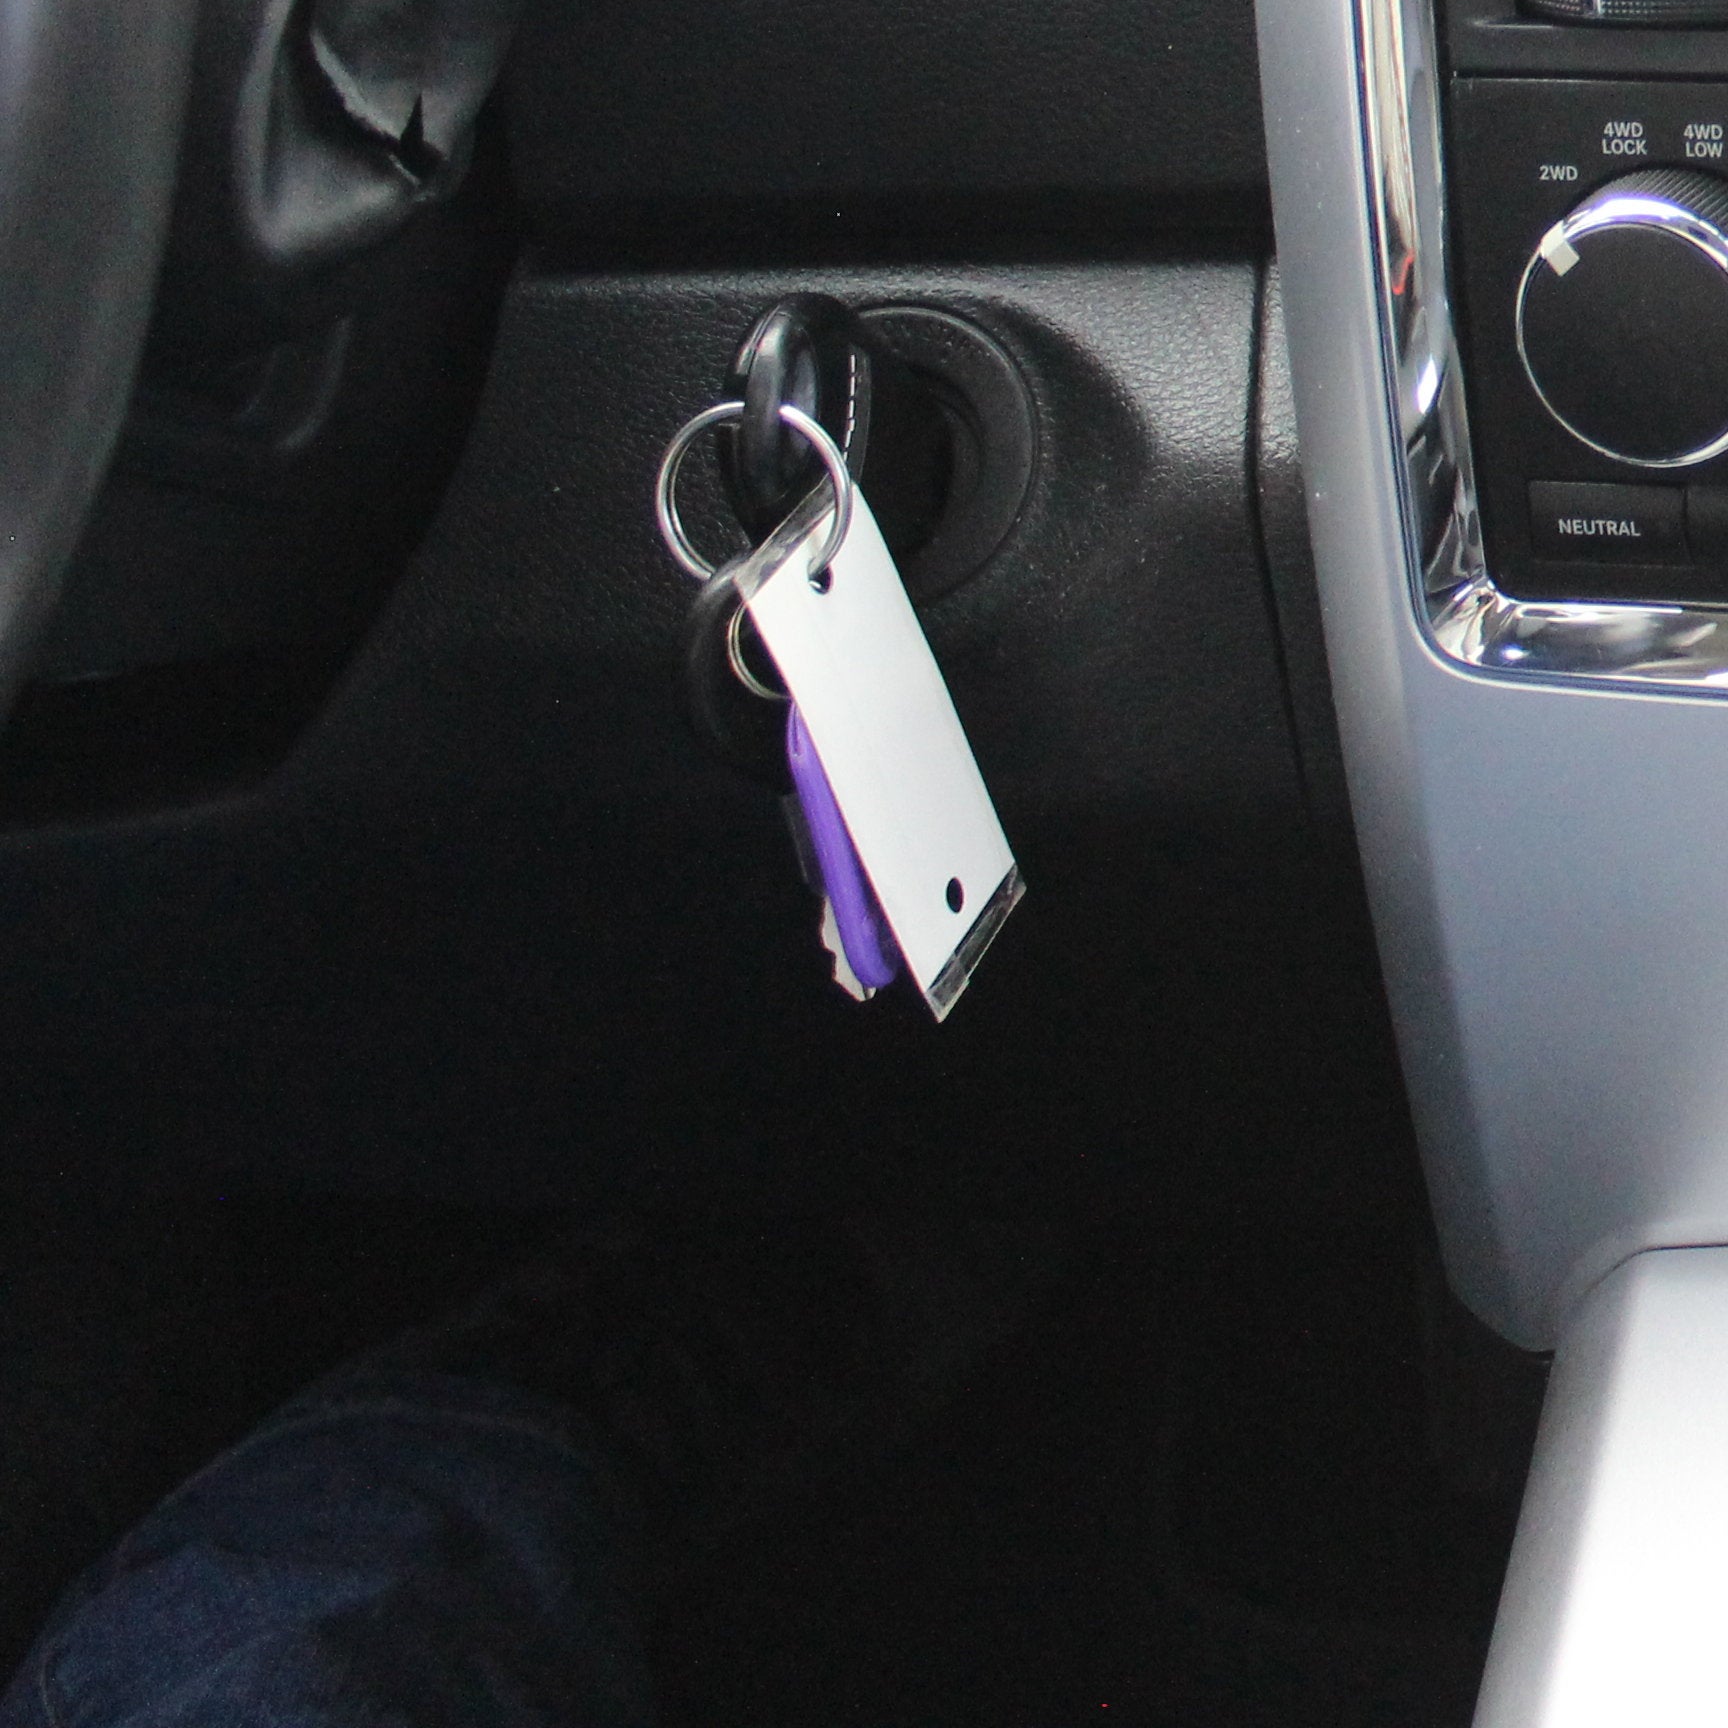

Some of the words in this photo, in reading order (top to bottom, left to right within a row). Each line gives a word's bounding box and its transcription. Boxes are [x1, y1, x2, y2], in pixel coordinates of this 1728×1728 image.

[1603, 121, 1644, 138] 4WD
[1683, 123, 1723, 140] 4WD
[1602, 139, 1648, 156] LOCK
[1685, 141, 1723, 158] LOW
[1539, 165, 1579, 182] 2WD
[1558, 518, 1642, 538] NEUTRAL
